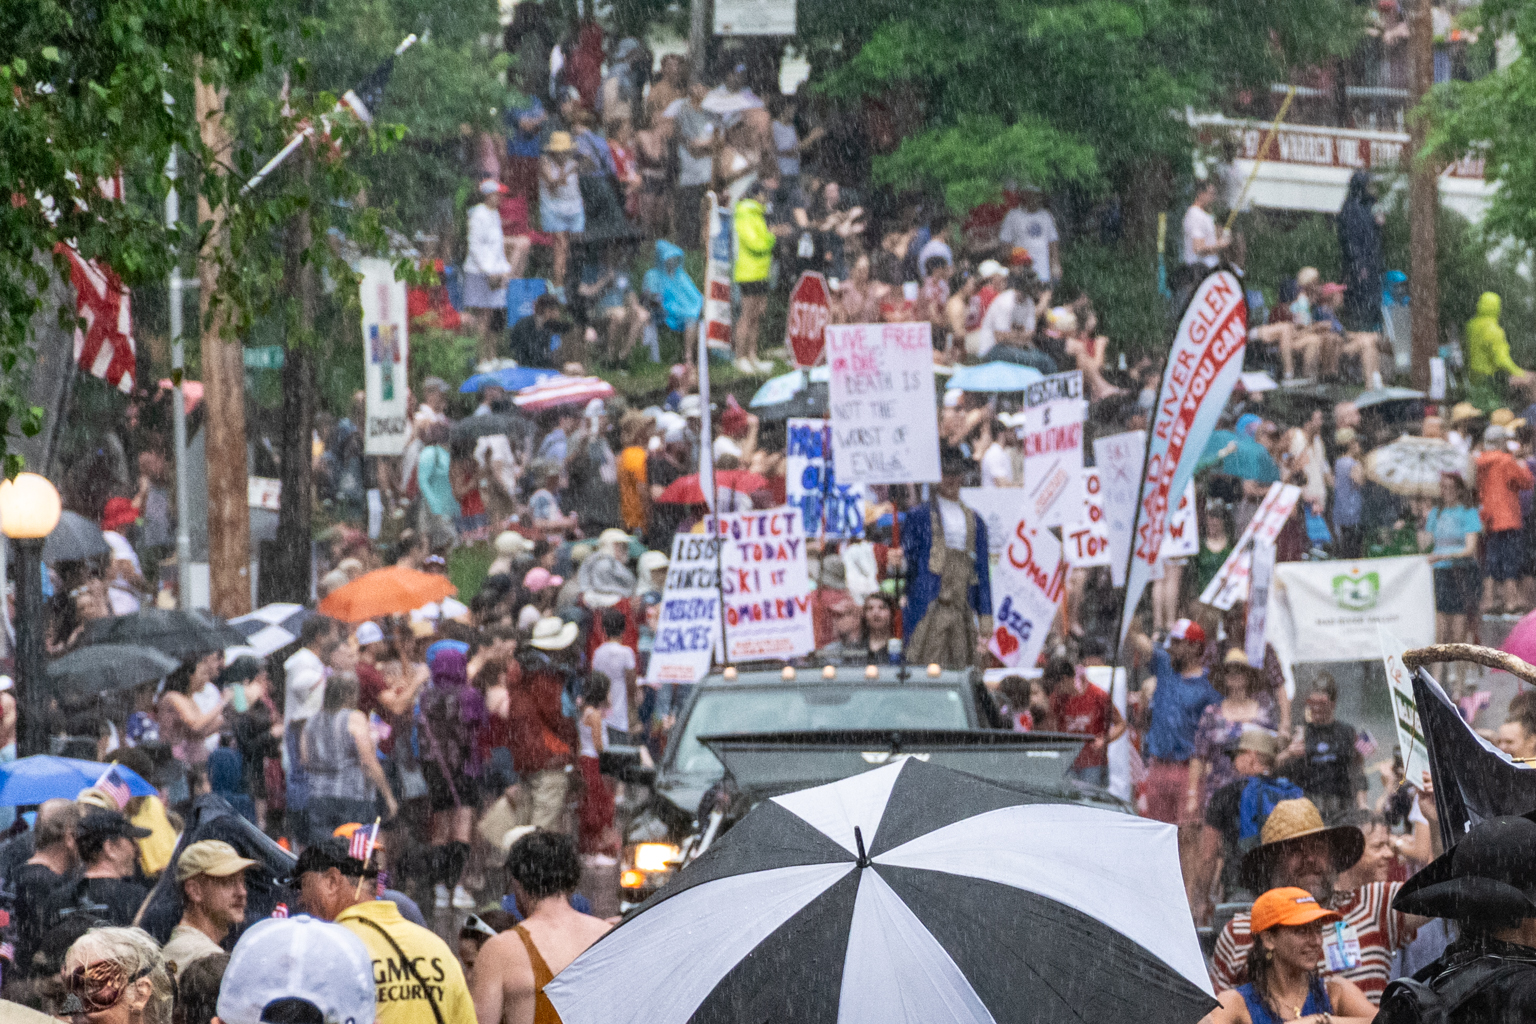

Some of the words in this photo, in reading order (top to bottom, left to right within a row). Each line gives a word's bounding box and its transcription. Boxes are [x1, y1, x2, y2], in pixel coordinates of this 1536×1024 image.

[790, 301, 828, 339] STOP
[829, 328, 867, 351] LIVE
[881, 325, 927, 350] FREE
[1156, 349, 1196, 439] RIVER
[1188, 274, 1234, 345] GLEN
[1182, 359, 1215, 411] YOU
[1210, 316, 1246, 362] CAN
[845, 371, 894, 395] DEATH
[902, 370, 922, 392] IS
[834, 402, 863, 421] NOT
[870, 401, 896, 419] THE
[834, 426, 886, 449] WORST
[706, 513, 796, 540] PROTECT
[737, 538, 800, 562] TODAY
[723, 565, 762, 594] SKI
[770, 569, 786, 586] IT
[724, 595, 811, 627] OMORROW
[372, 956, 446, 985] GMCS
[376, 985, 445, 1003] ECURITY
